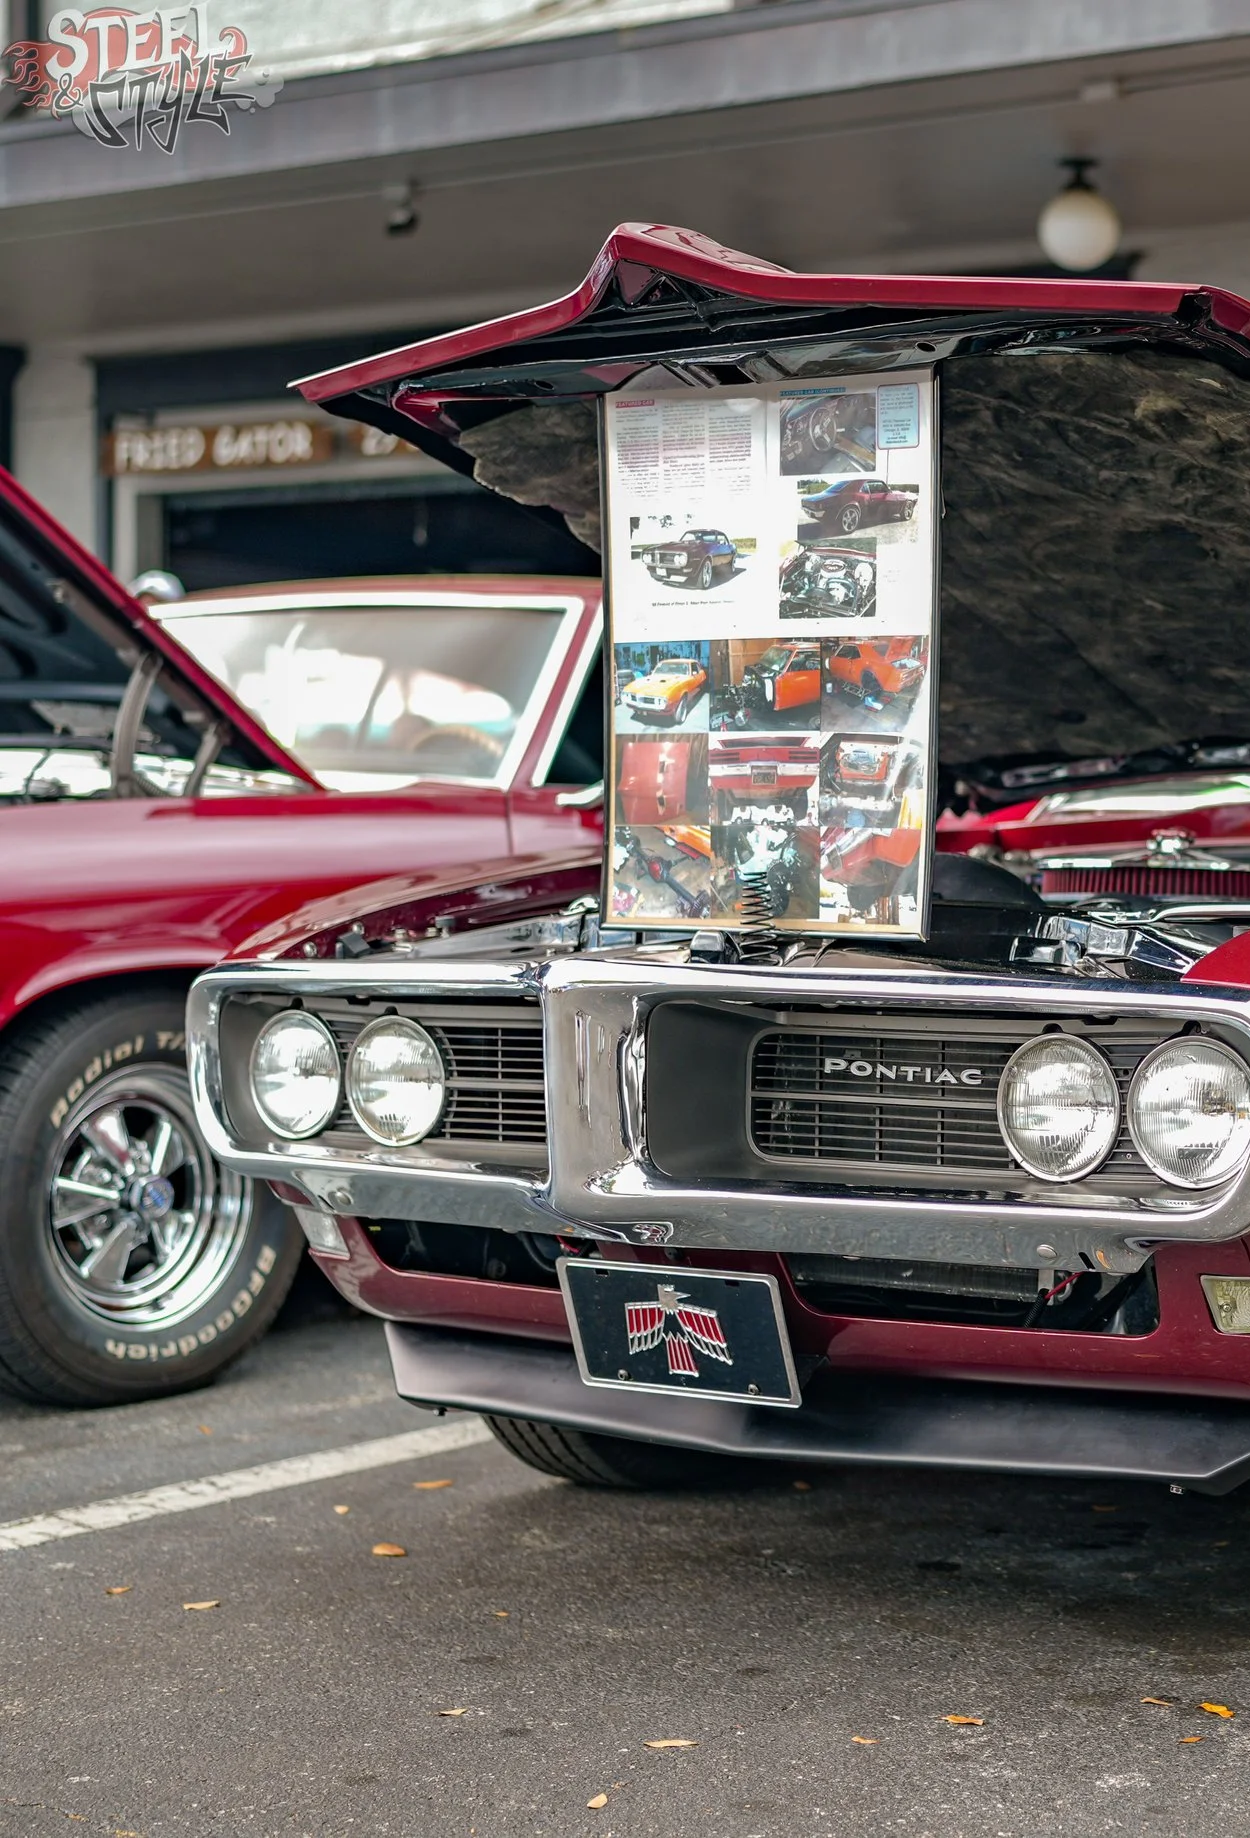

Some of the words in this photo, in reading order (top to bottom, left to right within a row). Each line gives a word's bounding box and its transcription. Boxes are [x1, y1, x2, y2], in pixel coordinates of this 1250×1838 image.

[114, 426, 205, 472] FRIED
[212, 419, 313, 467] GATOR
[51, 1035, 145, 1128] Radial
[156, 1030, 186, 1051] T/
[823, 1057, 983, 1085] PONTIAC
